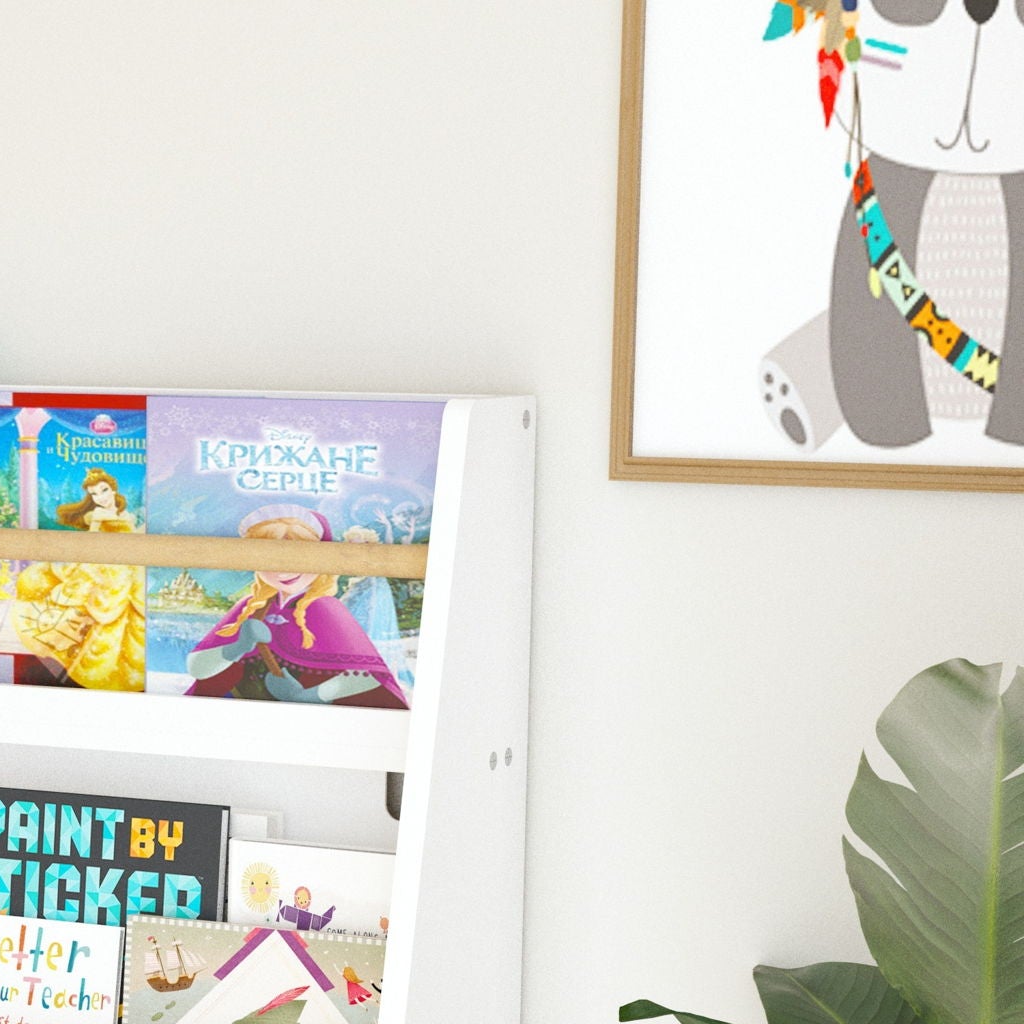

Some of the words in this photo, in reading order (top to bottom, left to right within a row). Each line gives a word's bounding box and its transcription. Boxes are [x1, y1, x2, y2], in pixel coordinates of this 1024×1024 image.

[199, 440, 378, 476] КРИЖАНЕ
[236, 469, 338, 494] СЕРЦЕ
[129, 817, 184, 861] BY
[23, 976, 112, 1011] Teacher
